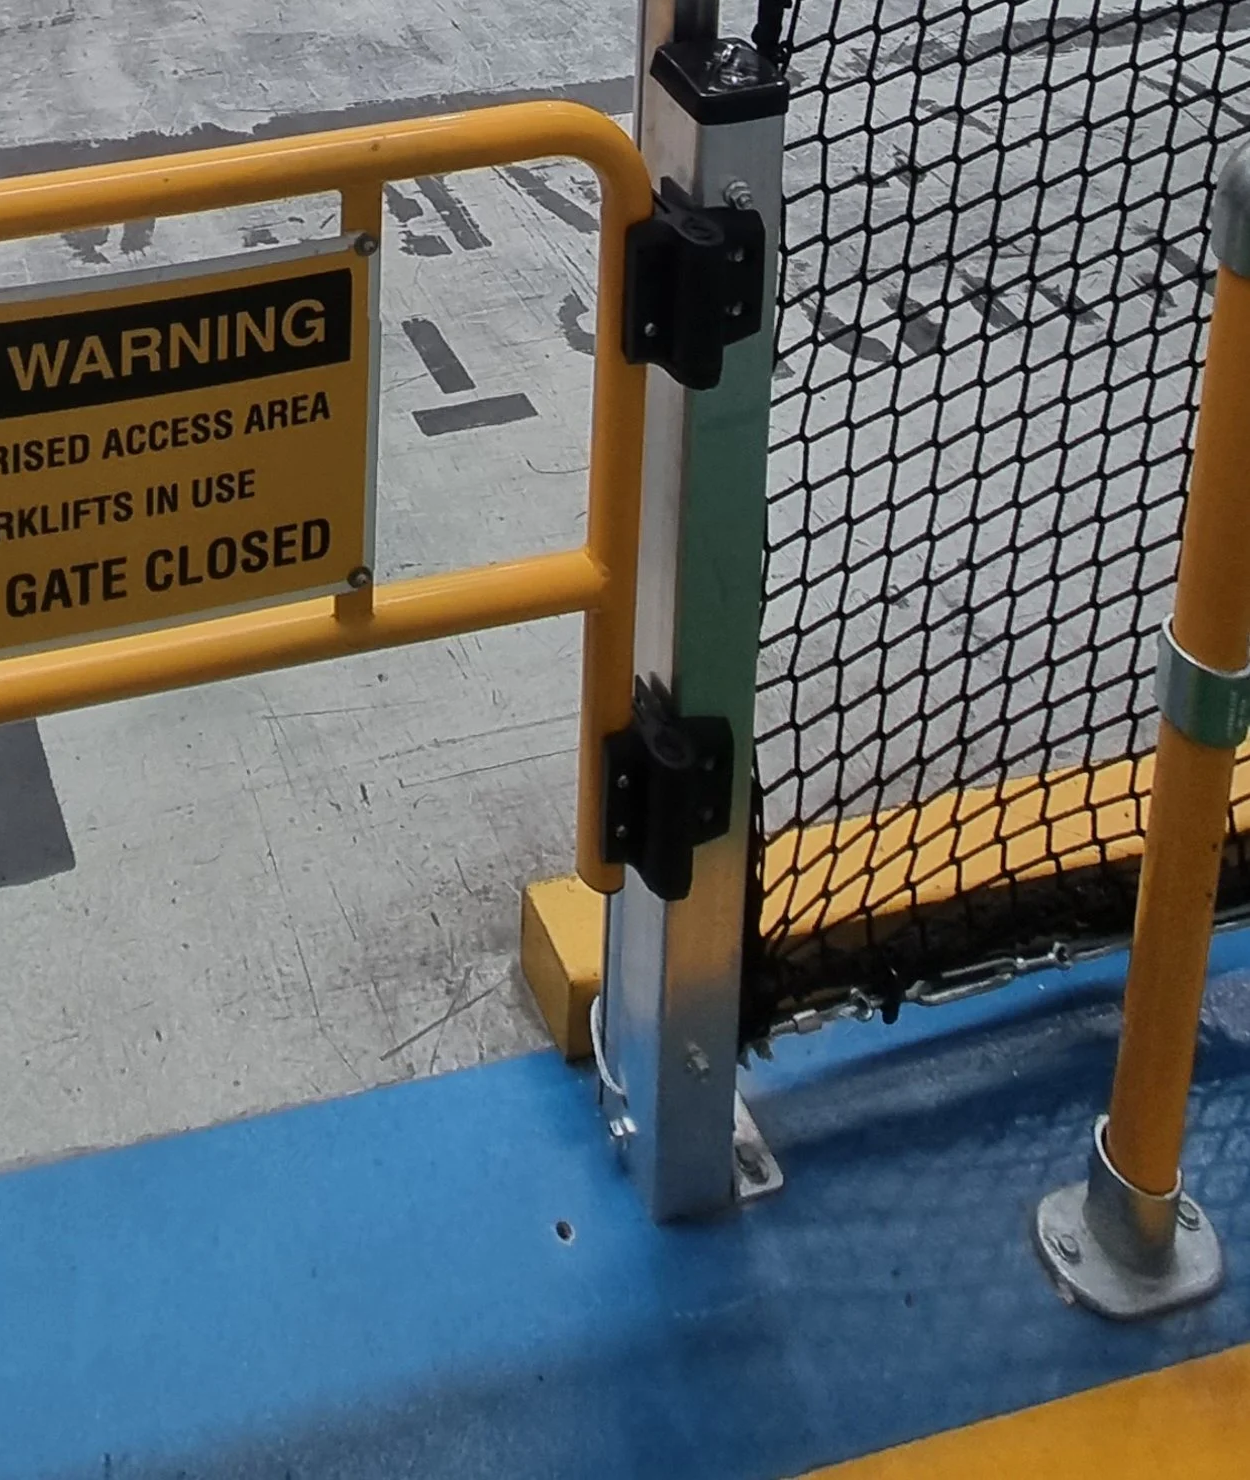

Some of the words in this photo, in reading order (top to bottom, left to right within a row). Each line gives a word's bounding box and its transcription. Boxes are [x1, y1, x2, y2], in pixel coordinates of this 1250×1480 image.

[7, 298, 326, 392] WARNING
[100, 408, 235, 461] ACCESS
[242, 390, 332, 436] AREA
[145, 481, 180, 518] IN
[190, 467, 257, 510] USE
[4, 555, 129, 619] GATE
[144, 516, 332, 594] CLOSED
